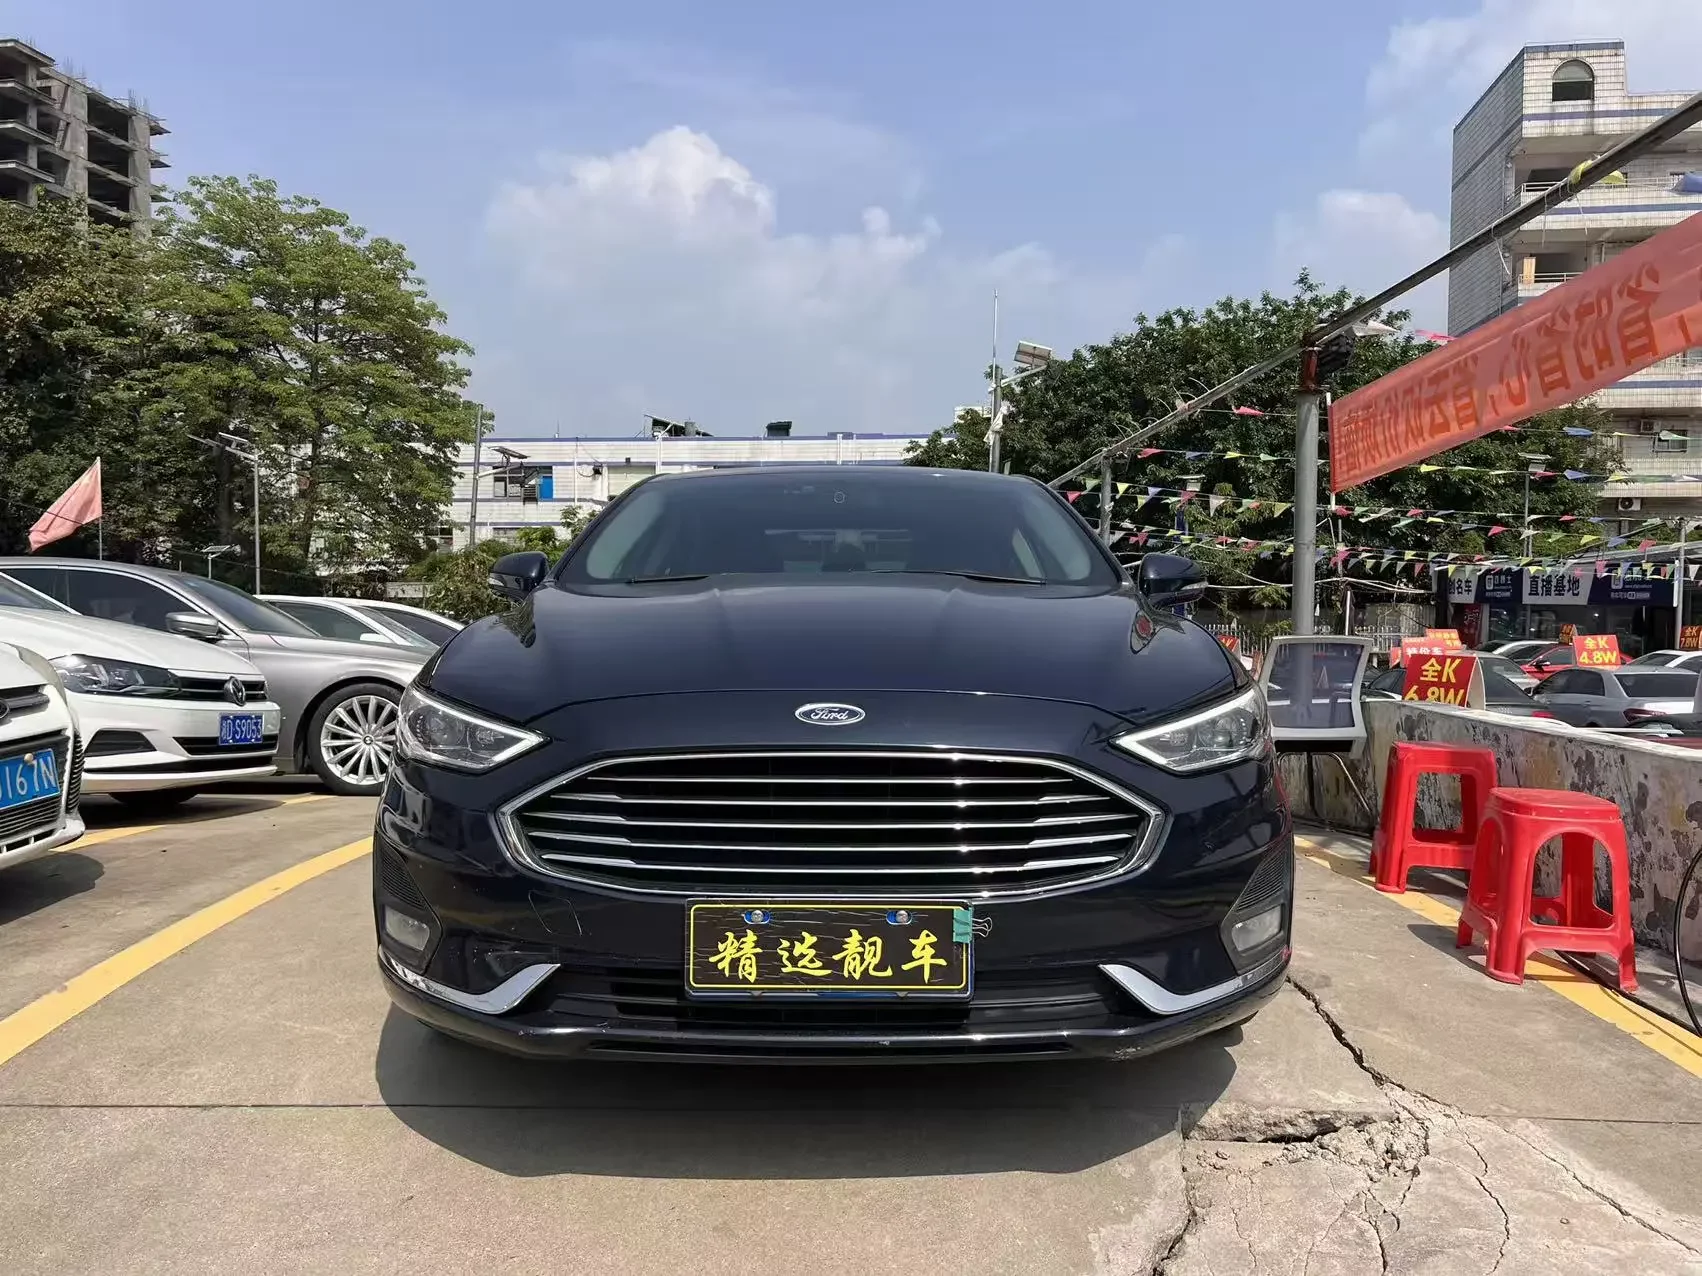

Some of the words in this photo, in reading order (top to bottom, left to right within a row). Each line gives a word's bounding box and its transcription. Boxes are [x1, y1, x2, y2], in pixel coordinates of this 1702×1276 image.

[1528, 574, 1580, 597] 直播基地
[1584, 637, 1610, 649] 全K
[1580, 650, 1618, 664] 4.8W
[1419, 657, 1462, 683] 全K
[1404, 685, 1465, 706] 68W
[0, 756, 57, 801] 167N
[708, 928, 948, 985] 精选靓车
